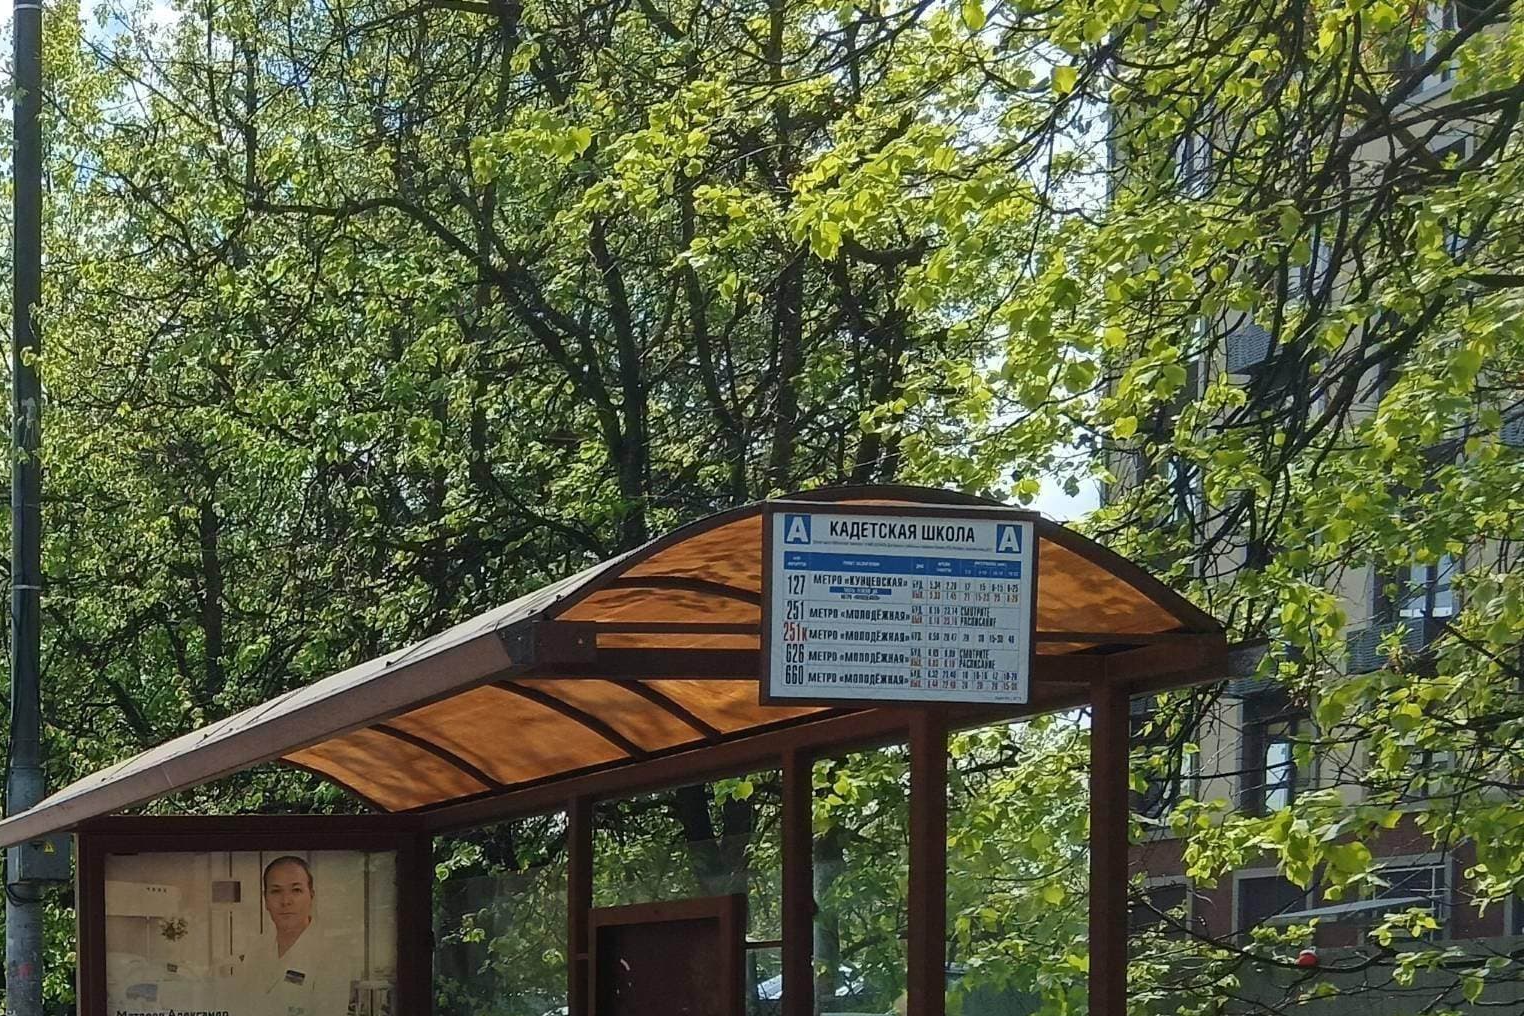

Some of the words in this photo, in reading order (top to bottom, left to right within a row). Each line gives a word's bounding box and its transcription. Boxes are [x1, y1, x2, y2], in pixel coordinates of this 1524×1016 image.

[830, 521, 917, 540] КАДЕТСКАЯ
[922, 525, 975, 543] ШКОЛА
[787, 574, 806, 595] 127
[813, 574, 842, 585] МЕТРО
[844, 575, 908, 588] «КУНЦЕВСКАЯ»
[786, 600, 804, 620] 251
[809, 608, 838, 618] МЕТРО
[841, 608, 910, 621] «МОЛОДЁЖНАЯ»
[809, 629, 837, 640] МЕТРО
[840, 629, 909, 642] «МОЛОДЁЖНАЯ»
[786, 644, 804, 663] 626
[808, 651, 837, 661] МЕТРО
[839, 651, 909, 664] «МОЛОДЁЖНАЯ»
[785, 665, 804, 685] 660
[808, 673, 836, 683] МЕТРО
[839, 673, 909, 685] «МОЛОДЁЖНАЯ»
